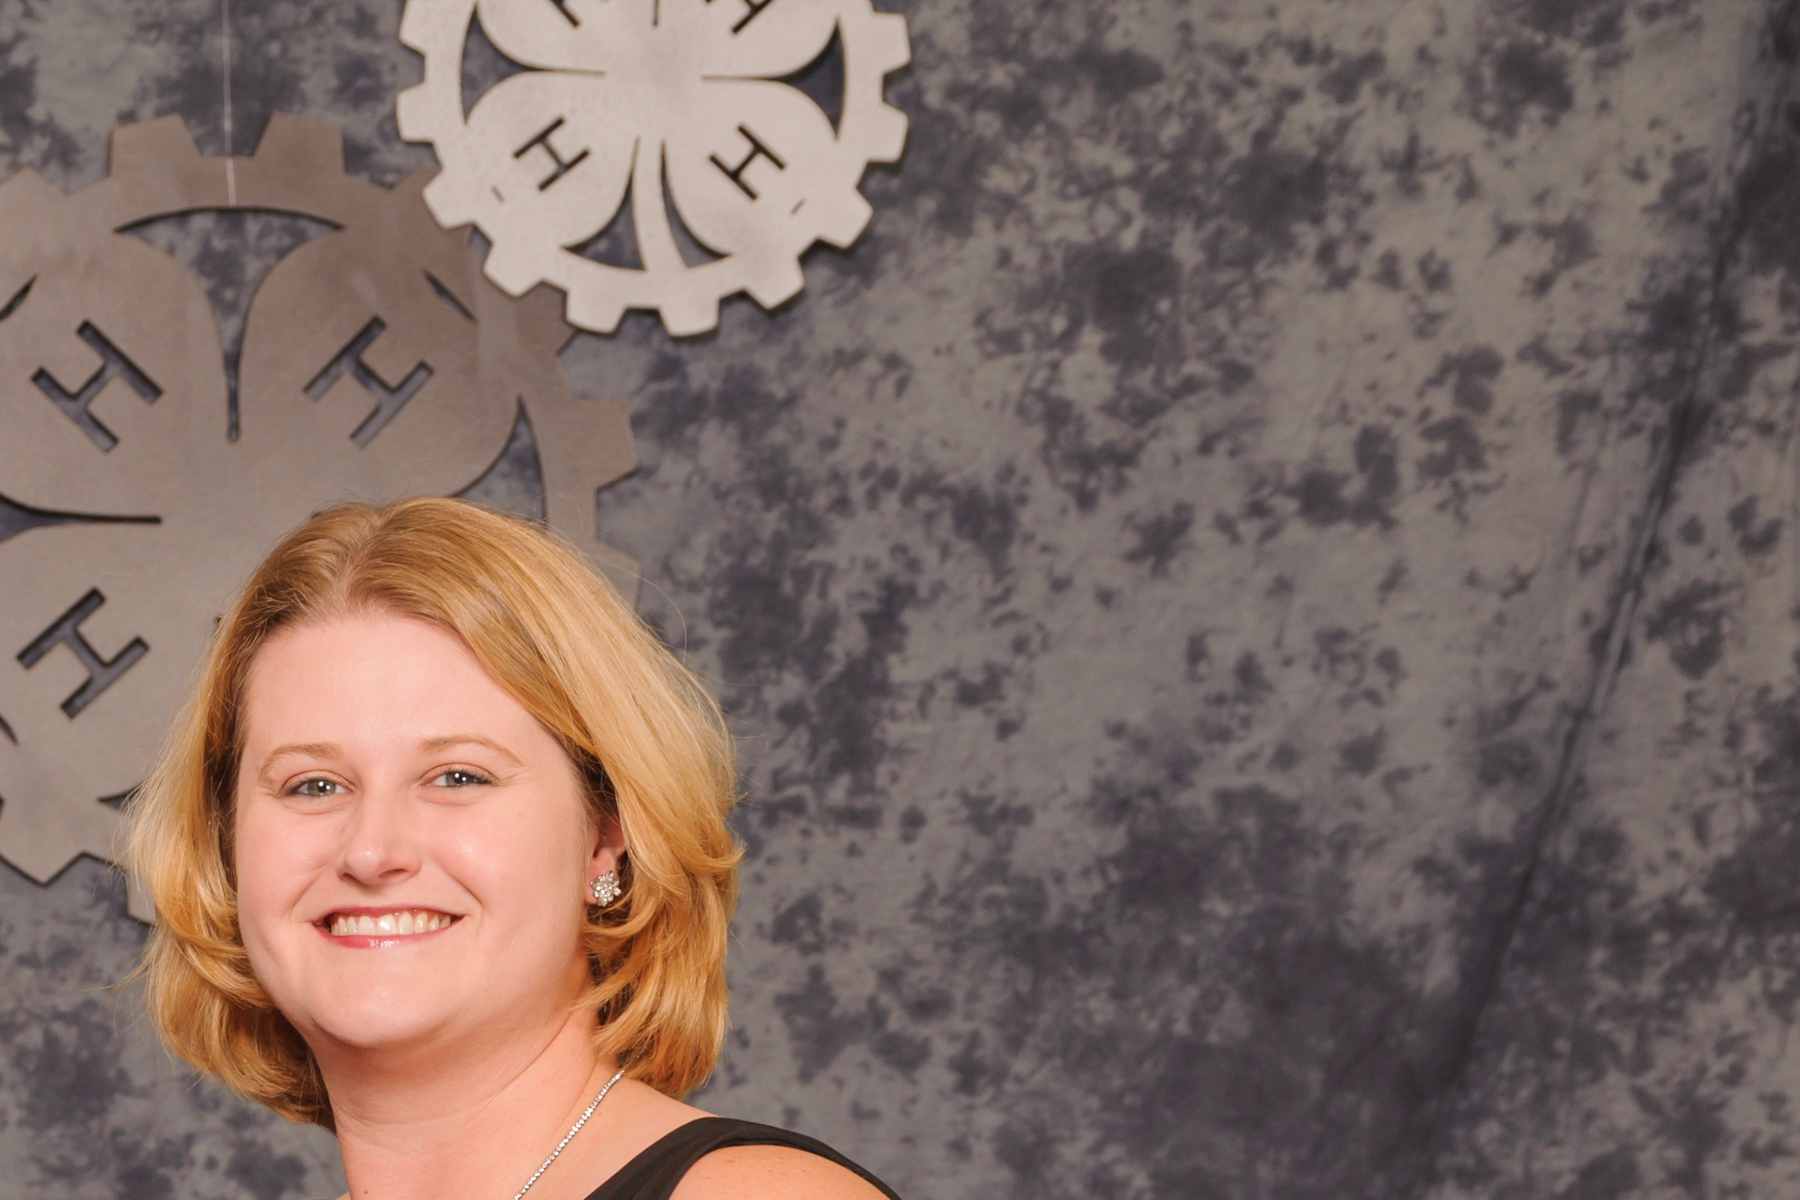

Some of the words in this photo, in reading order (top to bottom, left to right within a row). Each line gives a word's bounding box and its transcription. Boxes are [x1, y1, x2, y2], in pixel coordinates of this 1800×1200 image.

[514, 117, 588, 190] H
[709, 126, 785, 200] H
[31, 320, 162, 452] H
[303, 315, 433, 448] H
[16, 587, 149, 719] H
